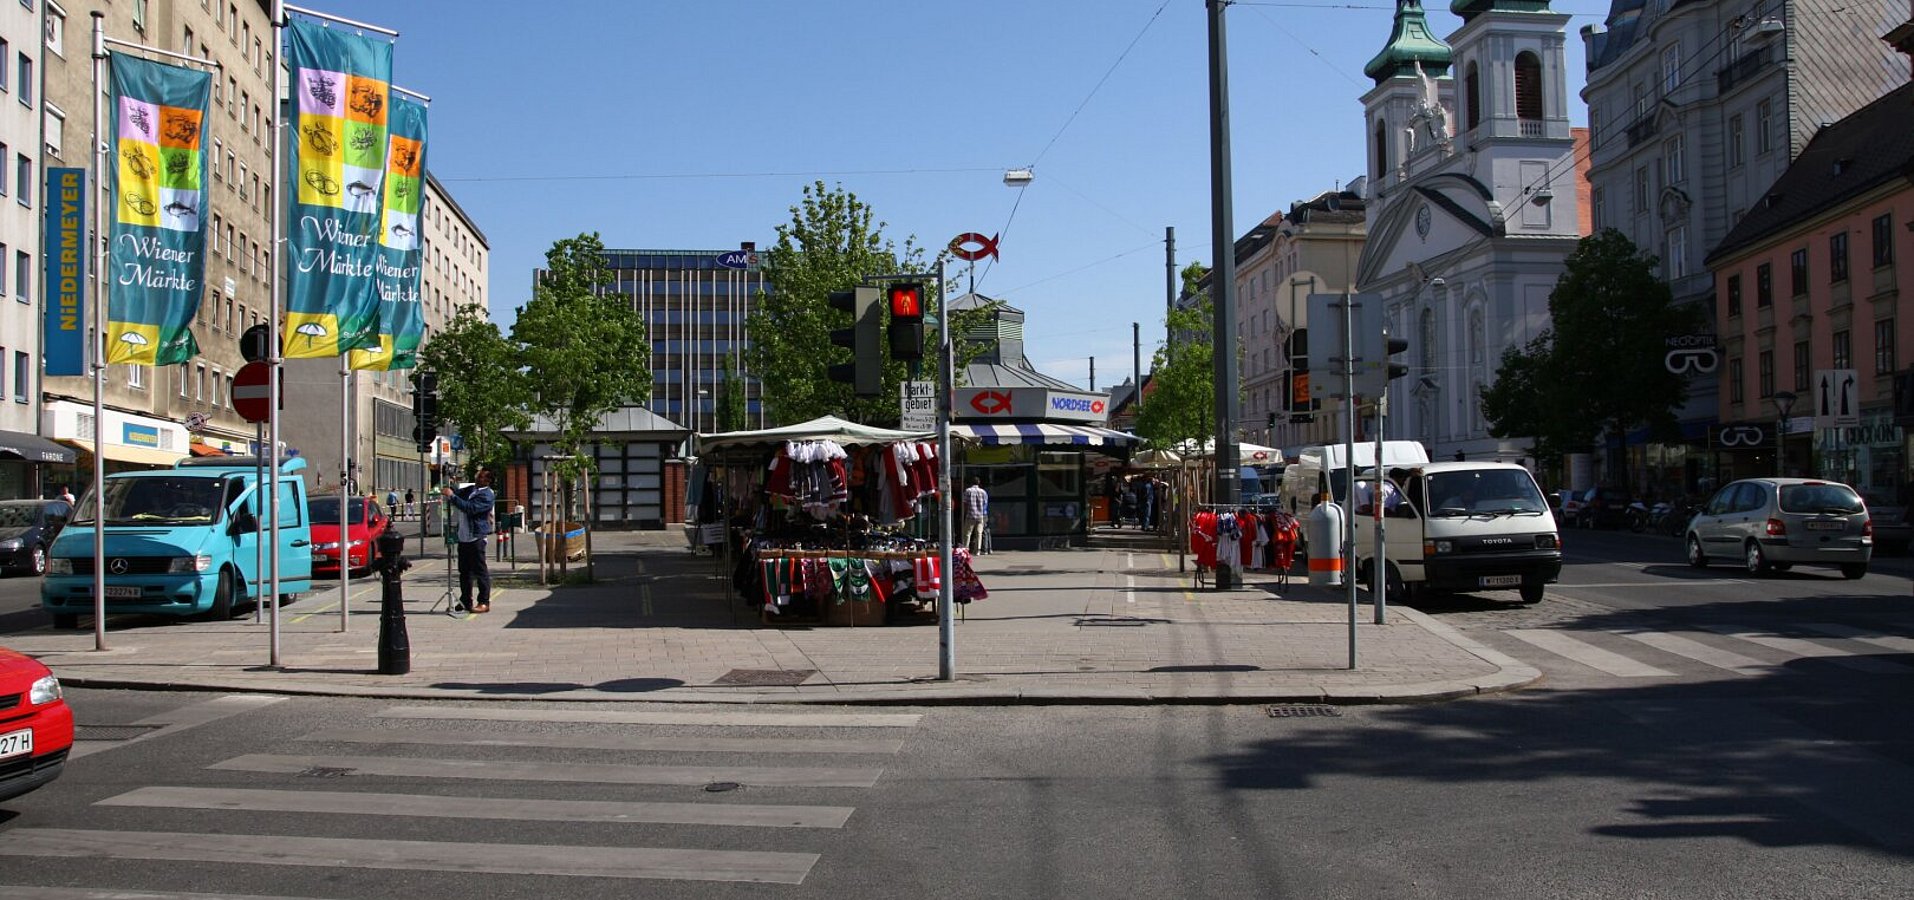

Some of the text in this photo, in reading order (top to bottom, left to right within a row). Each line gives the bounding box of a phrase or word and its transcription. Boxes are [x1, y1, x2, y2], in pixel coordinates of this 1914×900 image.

[119, 234, 196, 263] Wiener
[726, 254, 758, 265] AMS
[298, 248, 373, 277] Märkte
[119, 263, 196, 291] Märkte
[1052, 397, 1091, 412] NORDSEE
[0, 733, 30, 754] 27 H
